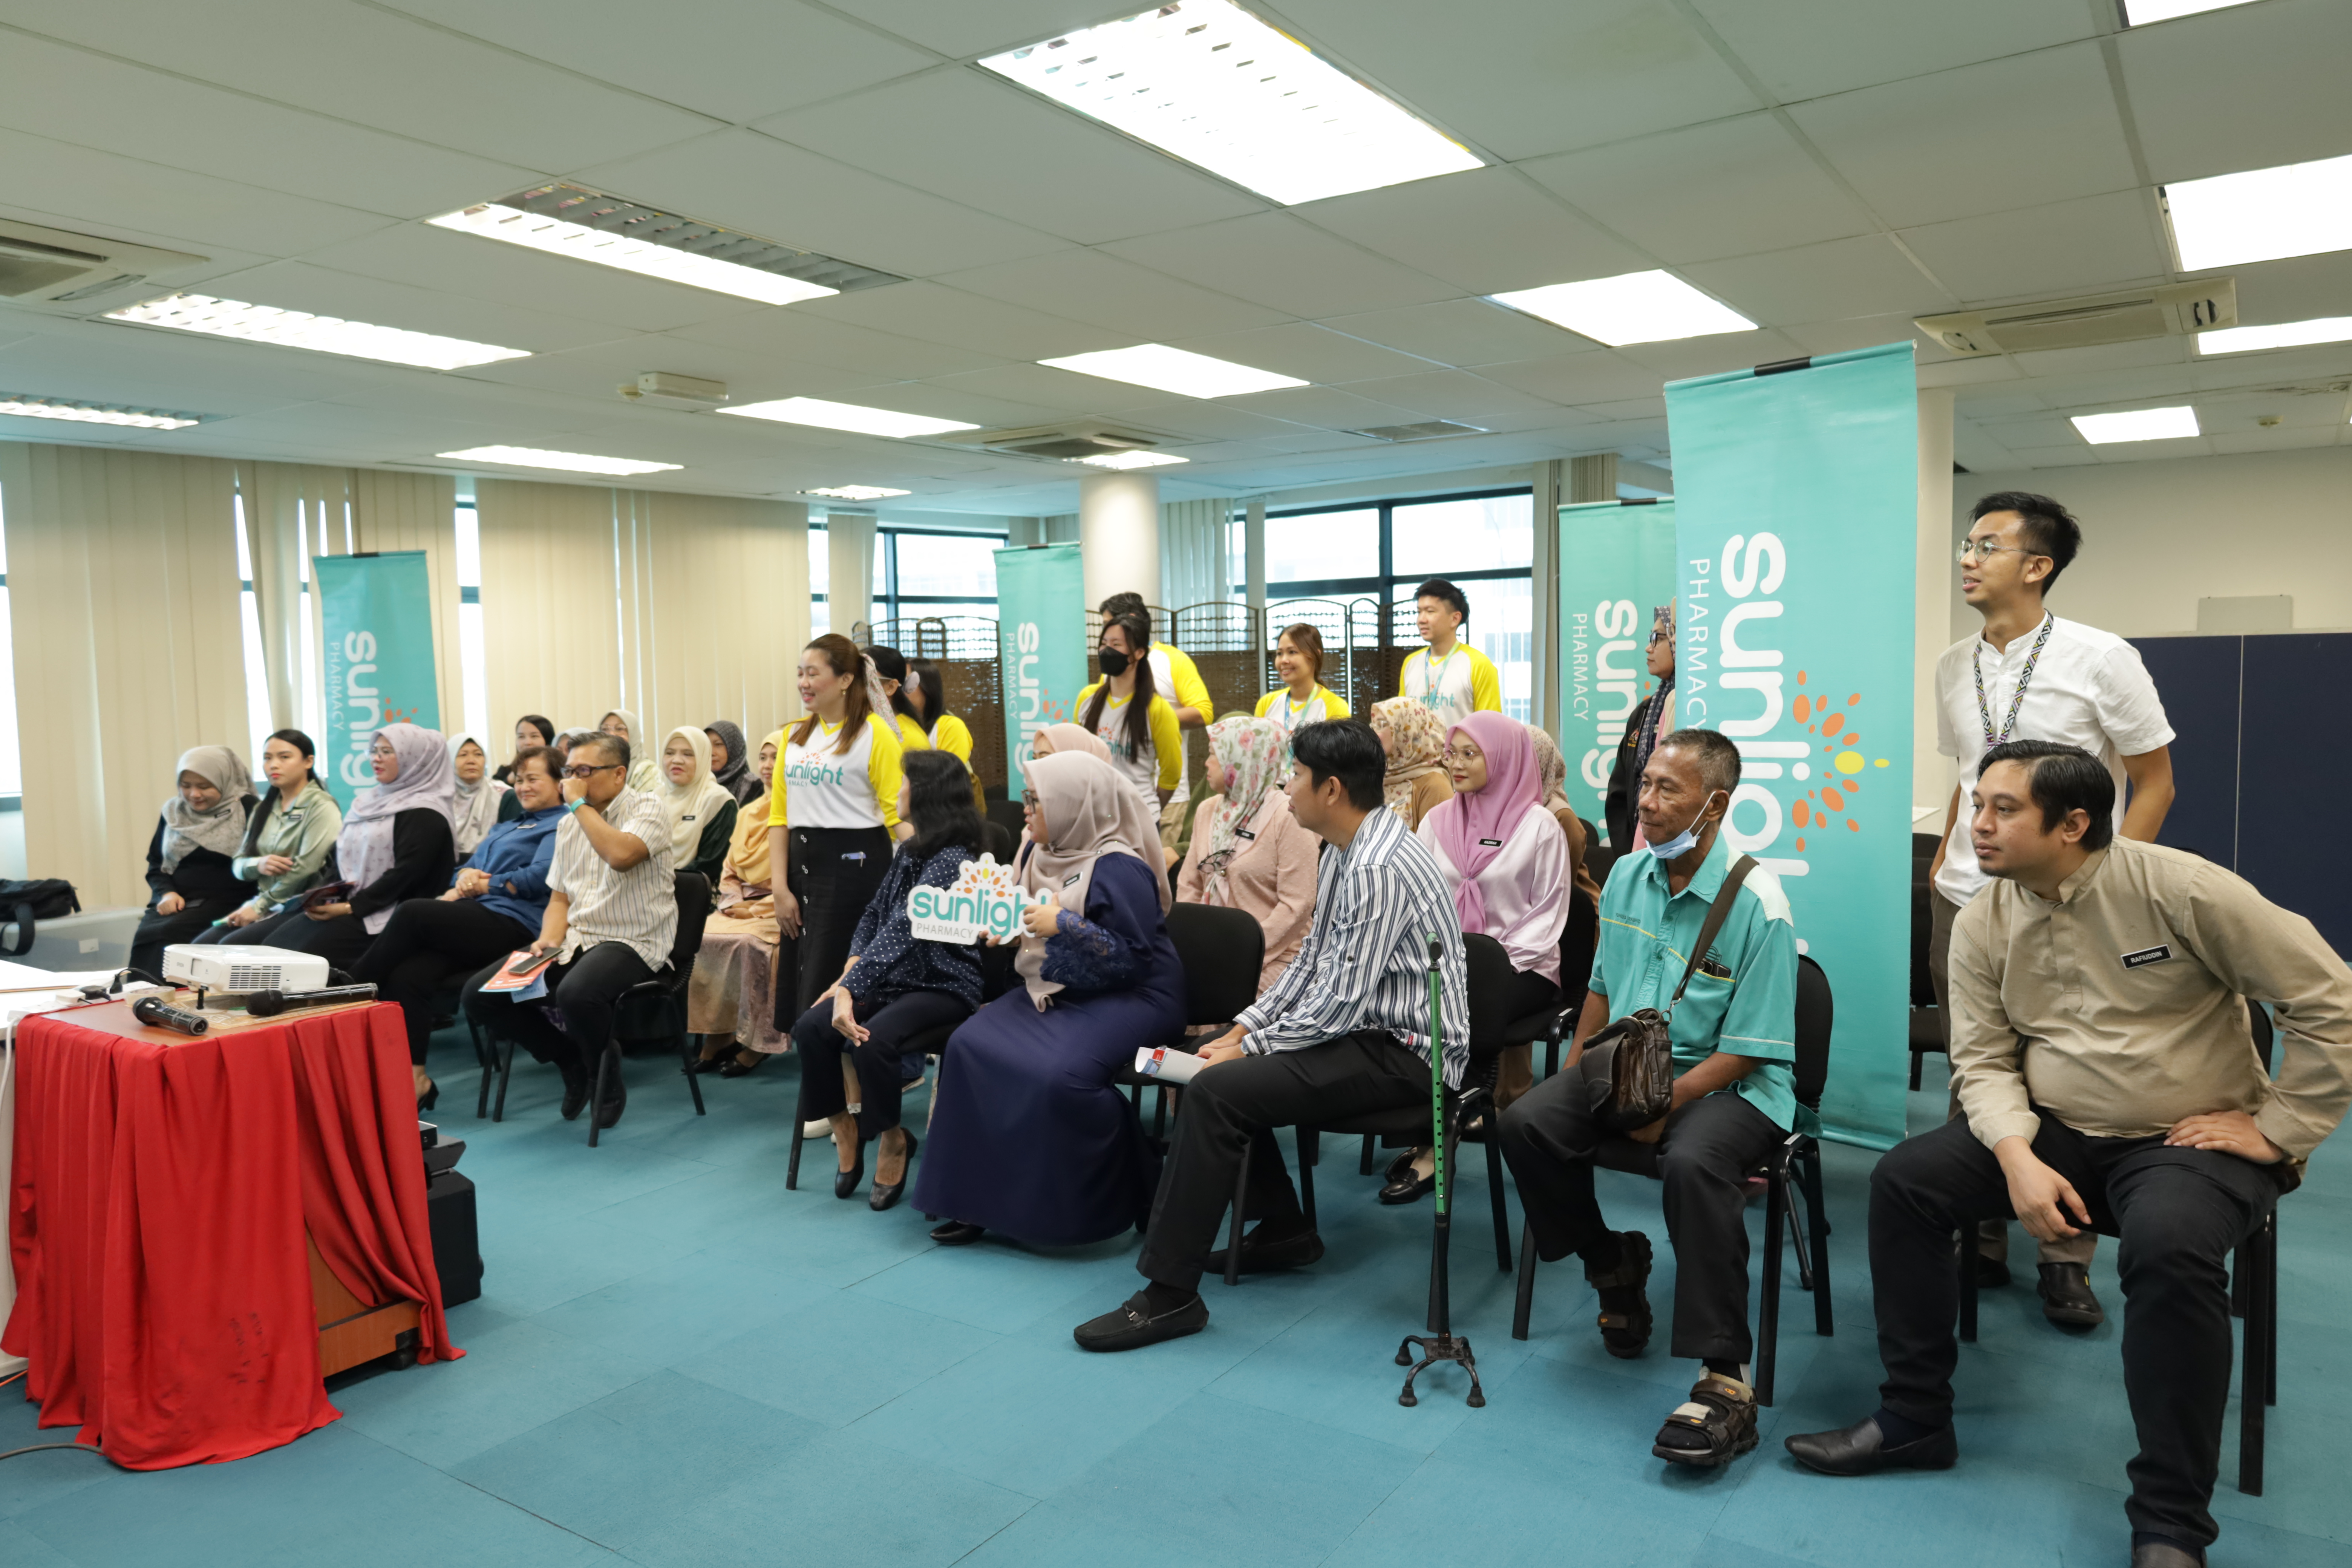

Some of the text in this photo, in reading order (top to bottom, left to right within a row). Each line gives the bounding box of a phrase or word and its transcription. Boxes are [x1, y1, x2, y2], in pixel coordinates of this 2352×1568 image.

[330, 642, 345, 730] PHARMACY
[1006, 633, 1018, 720] PHARMACY
[1573, 614, 1588, 720] PHARMACY
[1686, 559, 1710, 730] PHARMACY
[785, 761, 844, 786] unlight
[916, 923, 974, 939] PHARMACY
[2130, 951, 2163, 964] RAFIUDDIN
